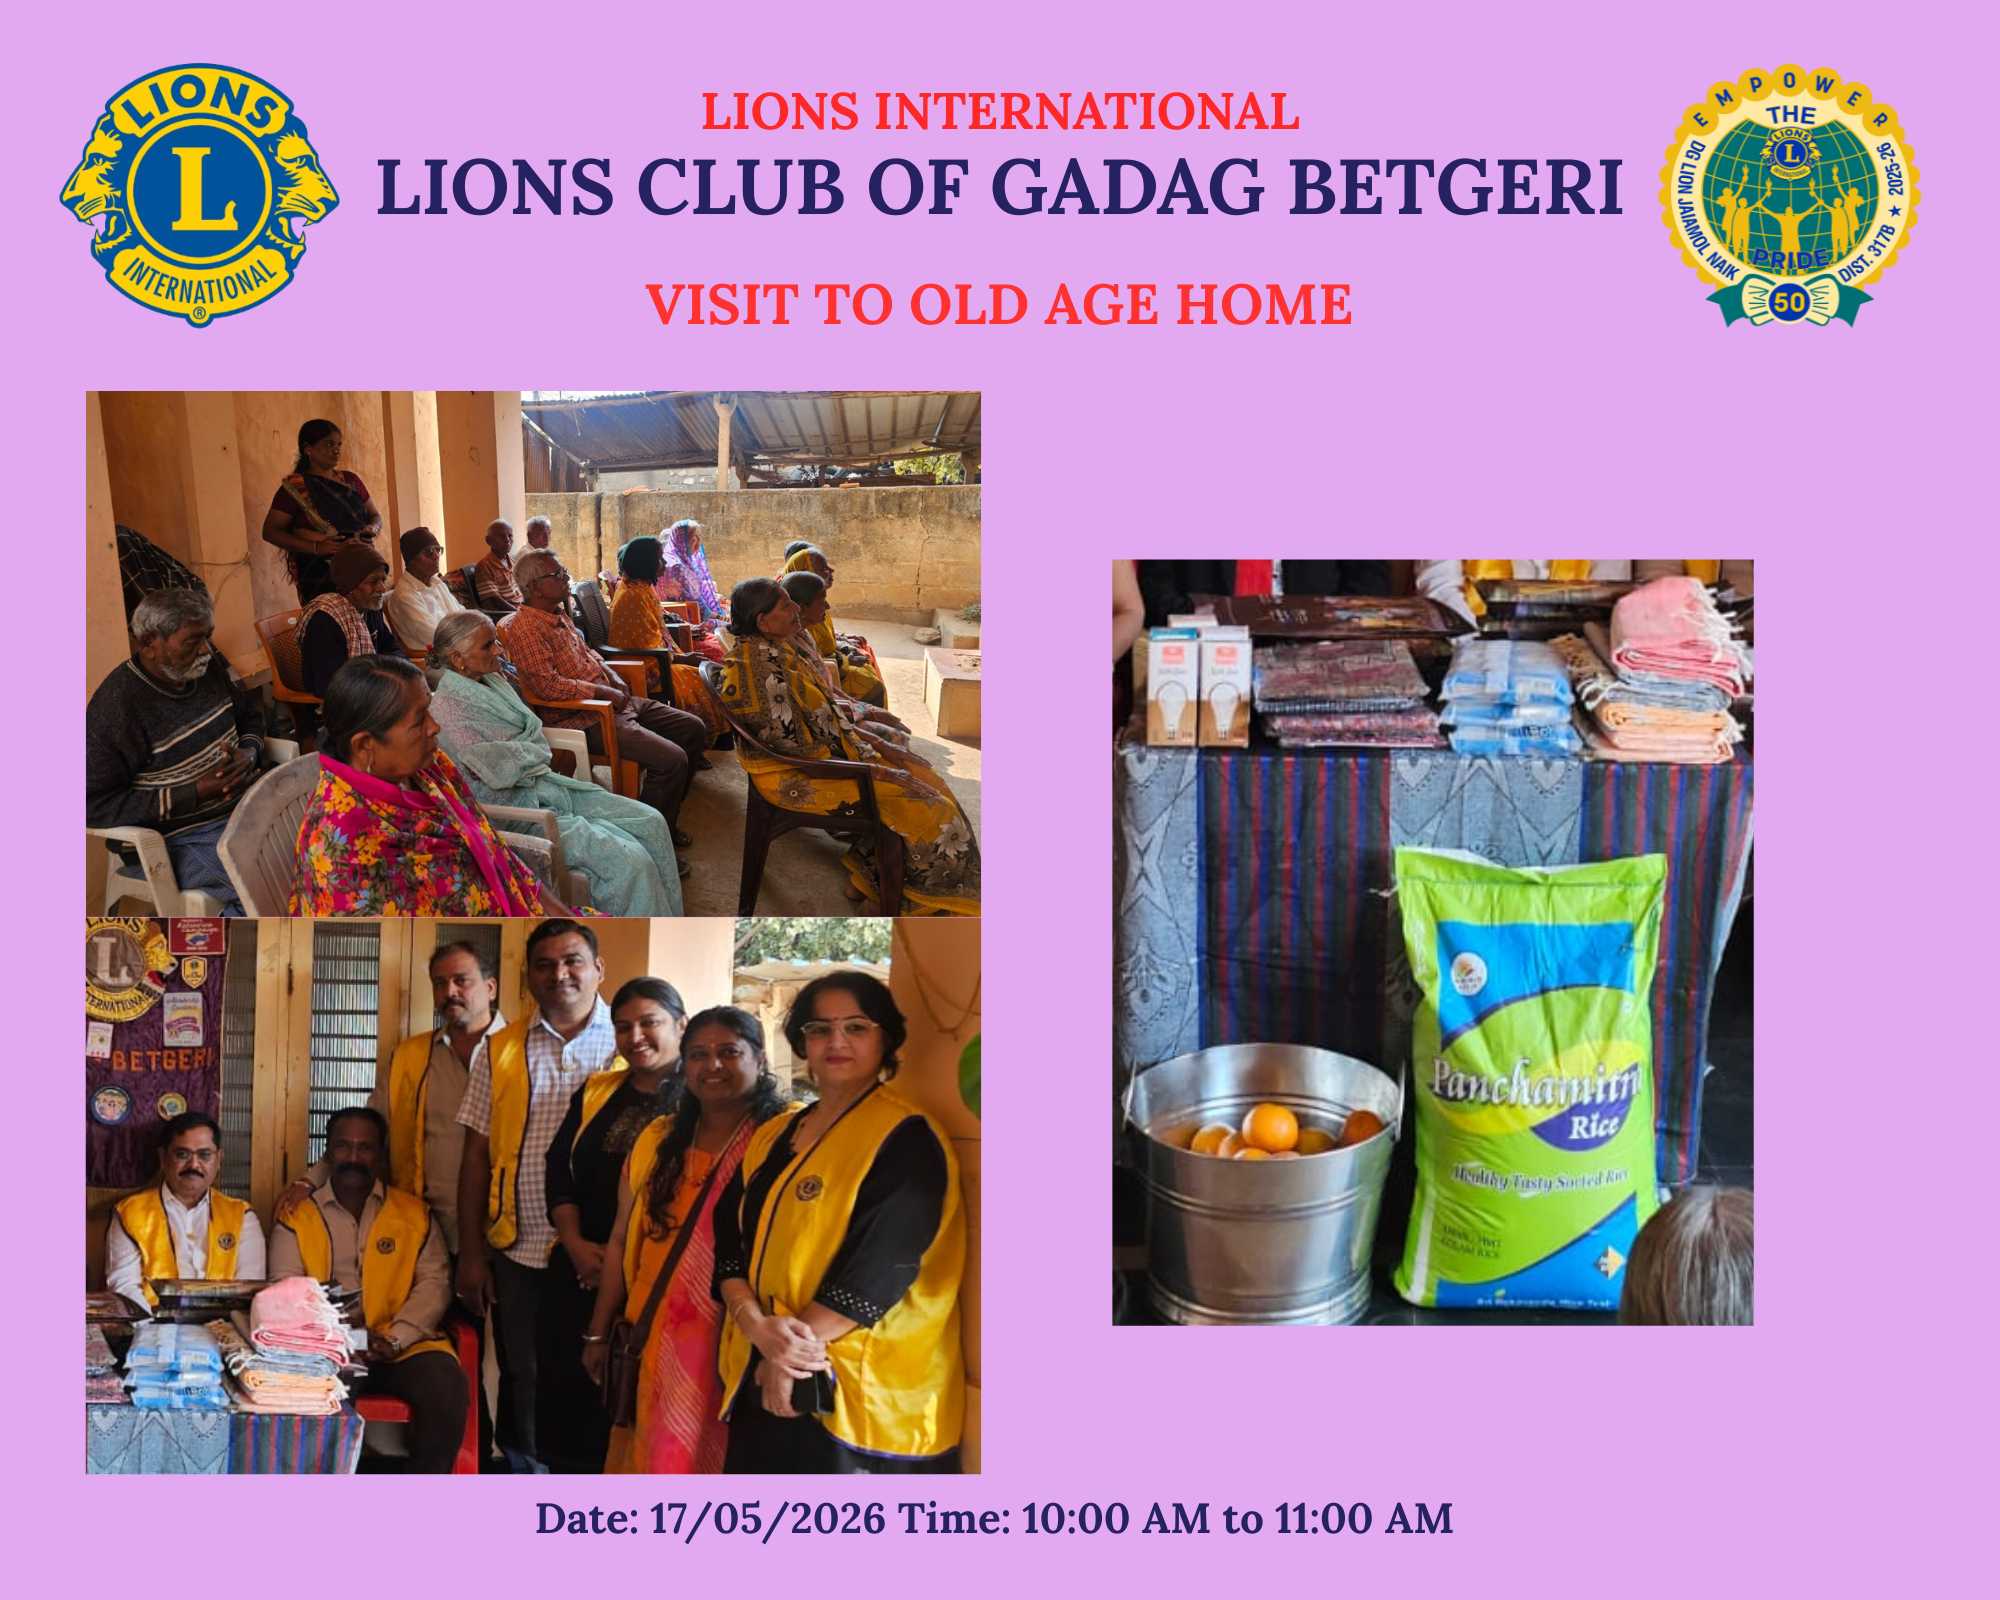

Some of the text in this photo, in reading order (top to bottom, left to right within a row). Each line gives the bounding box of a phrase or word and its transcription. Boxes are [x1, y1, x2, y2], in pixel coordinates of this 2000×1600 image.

[92, 936, 133, 985] L
[1568, 1112, 1620, 1140] Rice
[1454, 1164, 1508, 1194] Healthy
[1510, 1172, 1552, 1195] Tasty
[1557, 1170, 1602, 1191] Sorted
